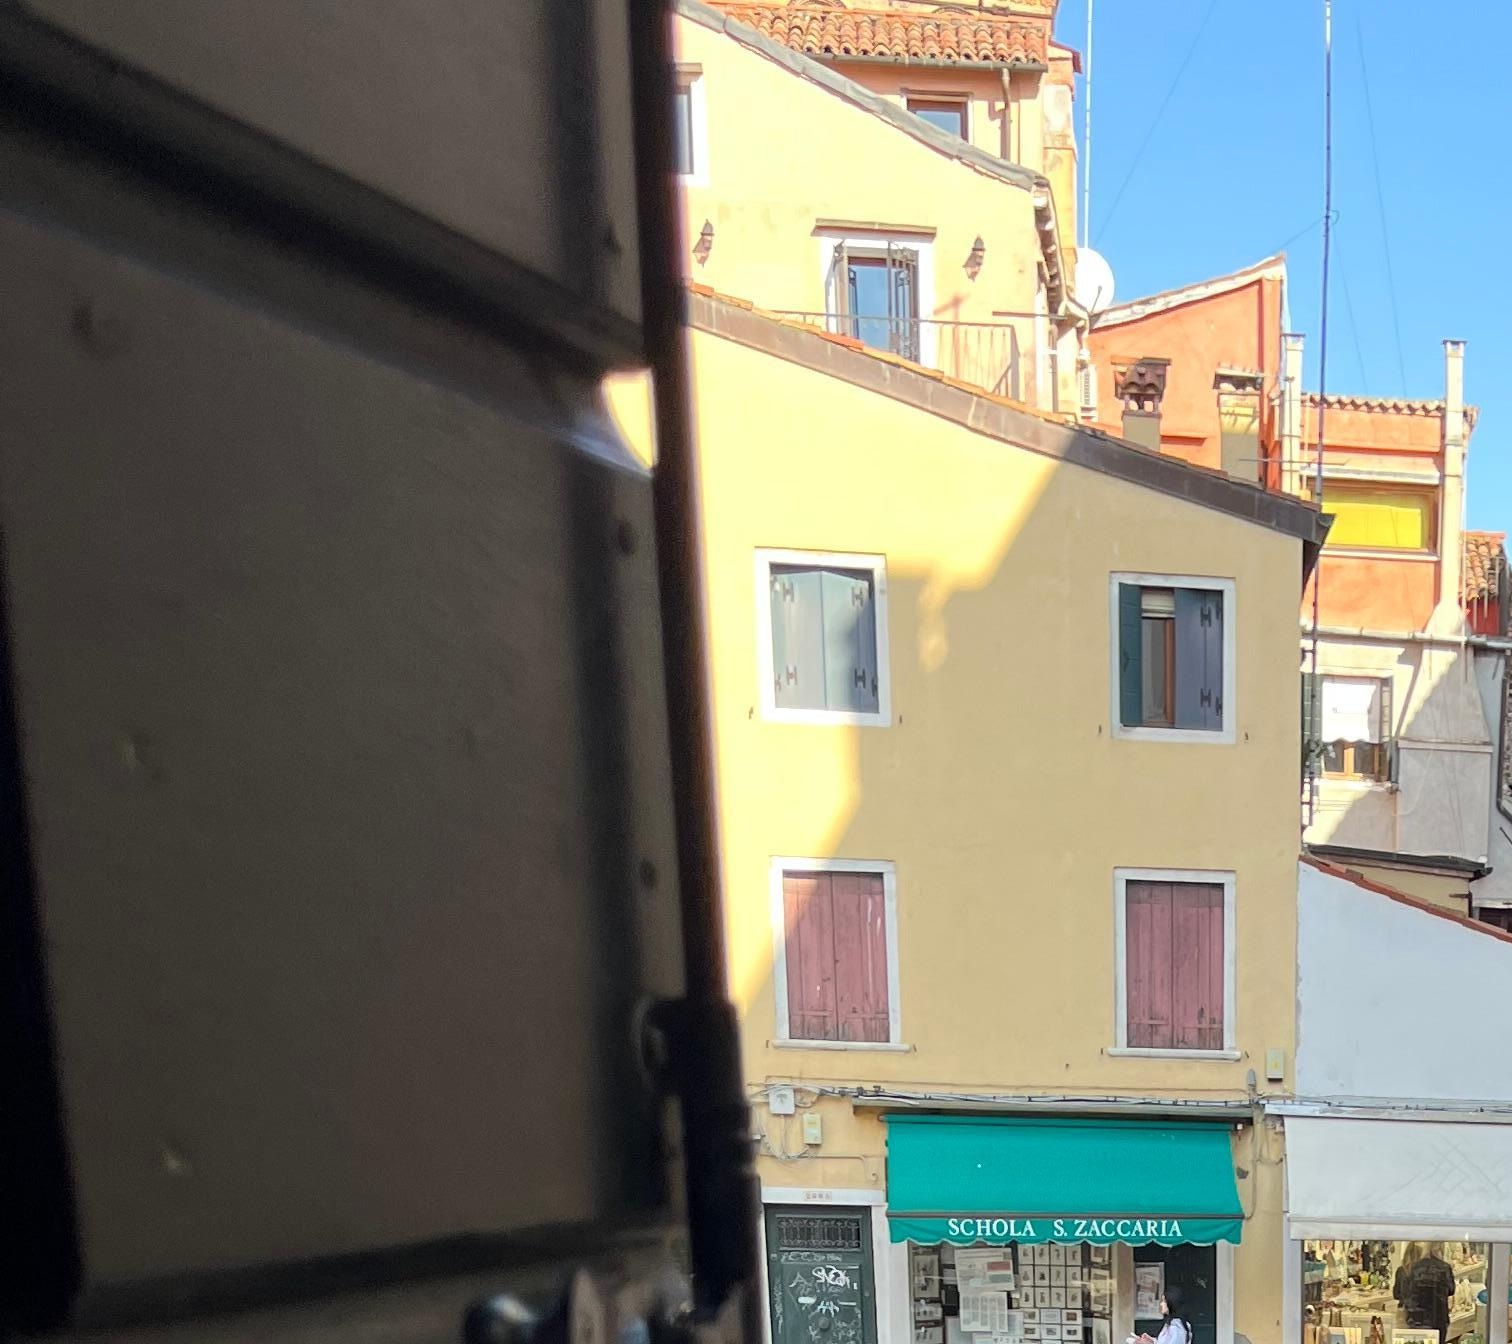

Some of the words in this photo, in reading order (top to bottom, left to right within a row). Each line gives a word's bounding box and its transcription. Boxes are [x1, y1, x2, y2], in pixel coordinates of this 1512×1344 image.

[948, 1218, 1035, 1236] SCHOLA
[1053, 1219, 1067, 1236] S.
[1074, 1219, 1182, 1236] ZACCARIA
